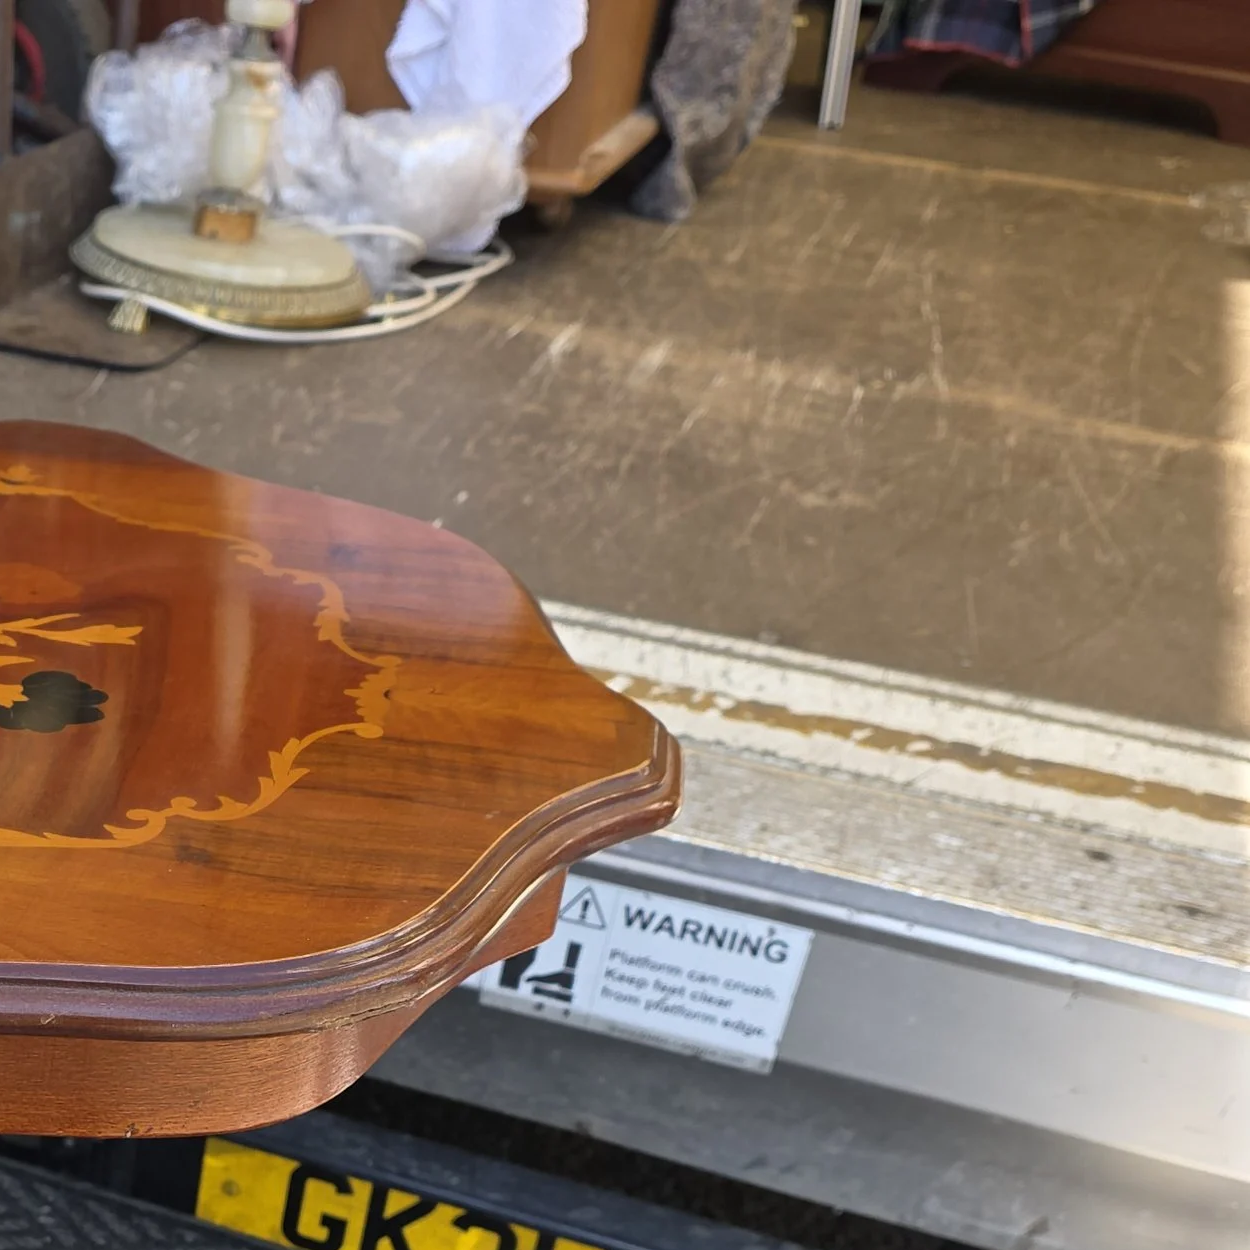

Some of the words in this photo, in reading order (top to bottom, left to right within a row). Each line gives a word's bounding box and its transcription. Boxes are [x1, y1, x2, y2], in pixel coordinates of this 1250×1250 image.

[623, 903, 789, 964] WARNING
[609, 948, 683, 977] Platform
[687, 969, 720, 986] can
[601, 986, 640, 1006] from
[644, 999, 718, 1026] platform
[604, 967, 649, 990] Keep
[653, 978, 686, 998] feet
[690, 990, 733, 1010] clear
